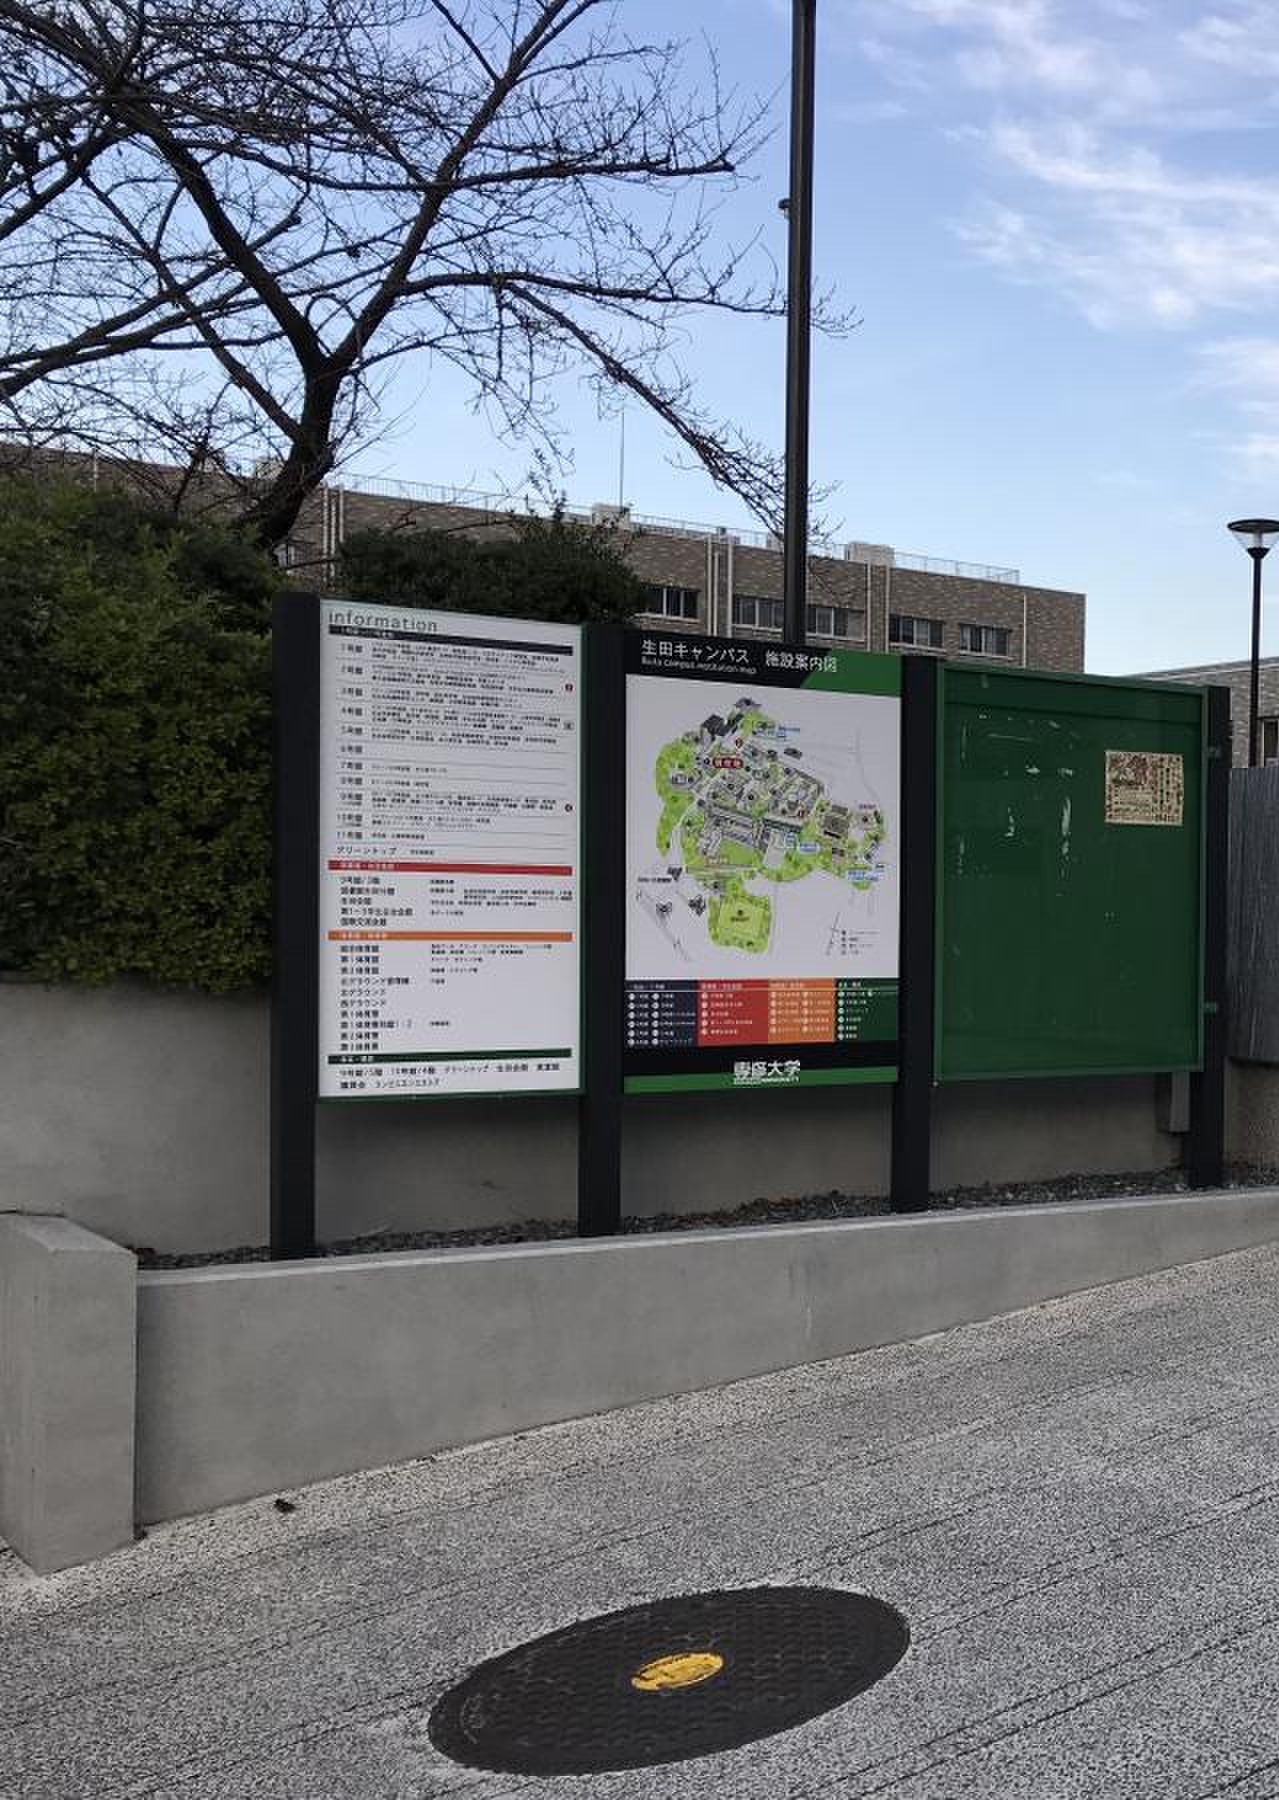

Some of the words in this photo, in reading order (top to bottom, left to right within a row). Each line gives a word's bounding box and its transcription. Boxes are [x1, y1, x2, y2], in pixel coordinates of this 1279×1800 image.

[328, 609, 438, 632] information
[641, 639, 750, 664] 生田キャンパス
[765, 650, 838, 673] 施設案内図
